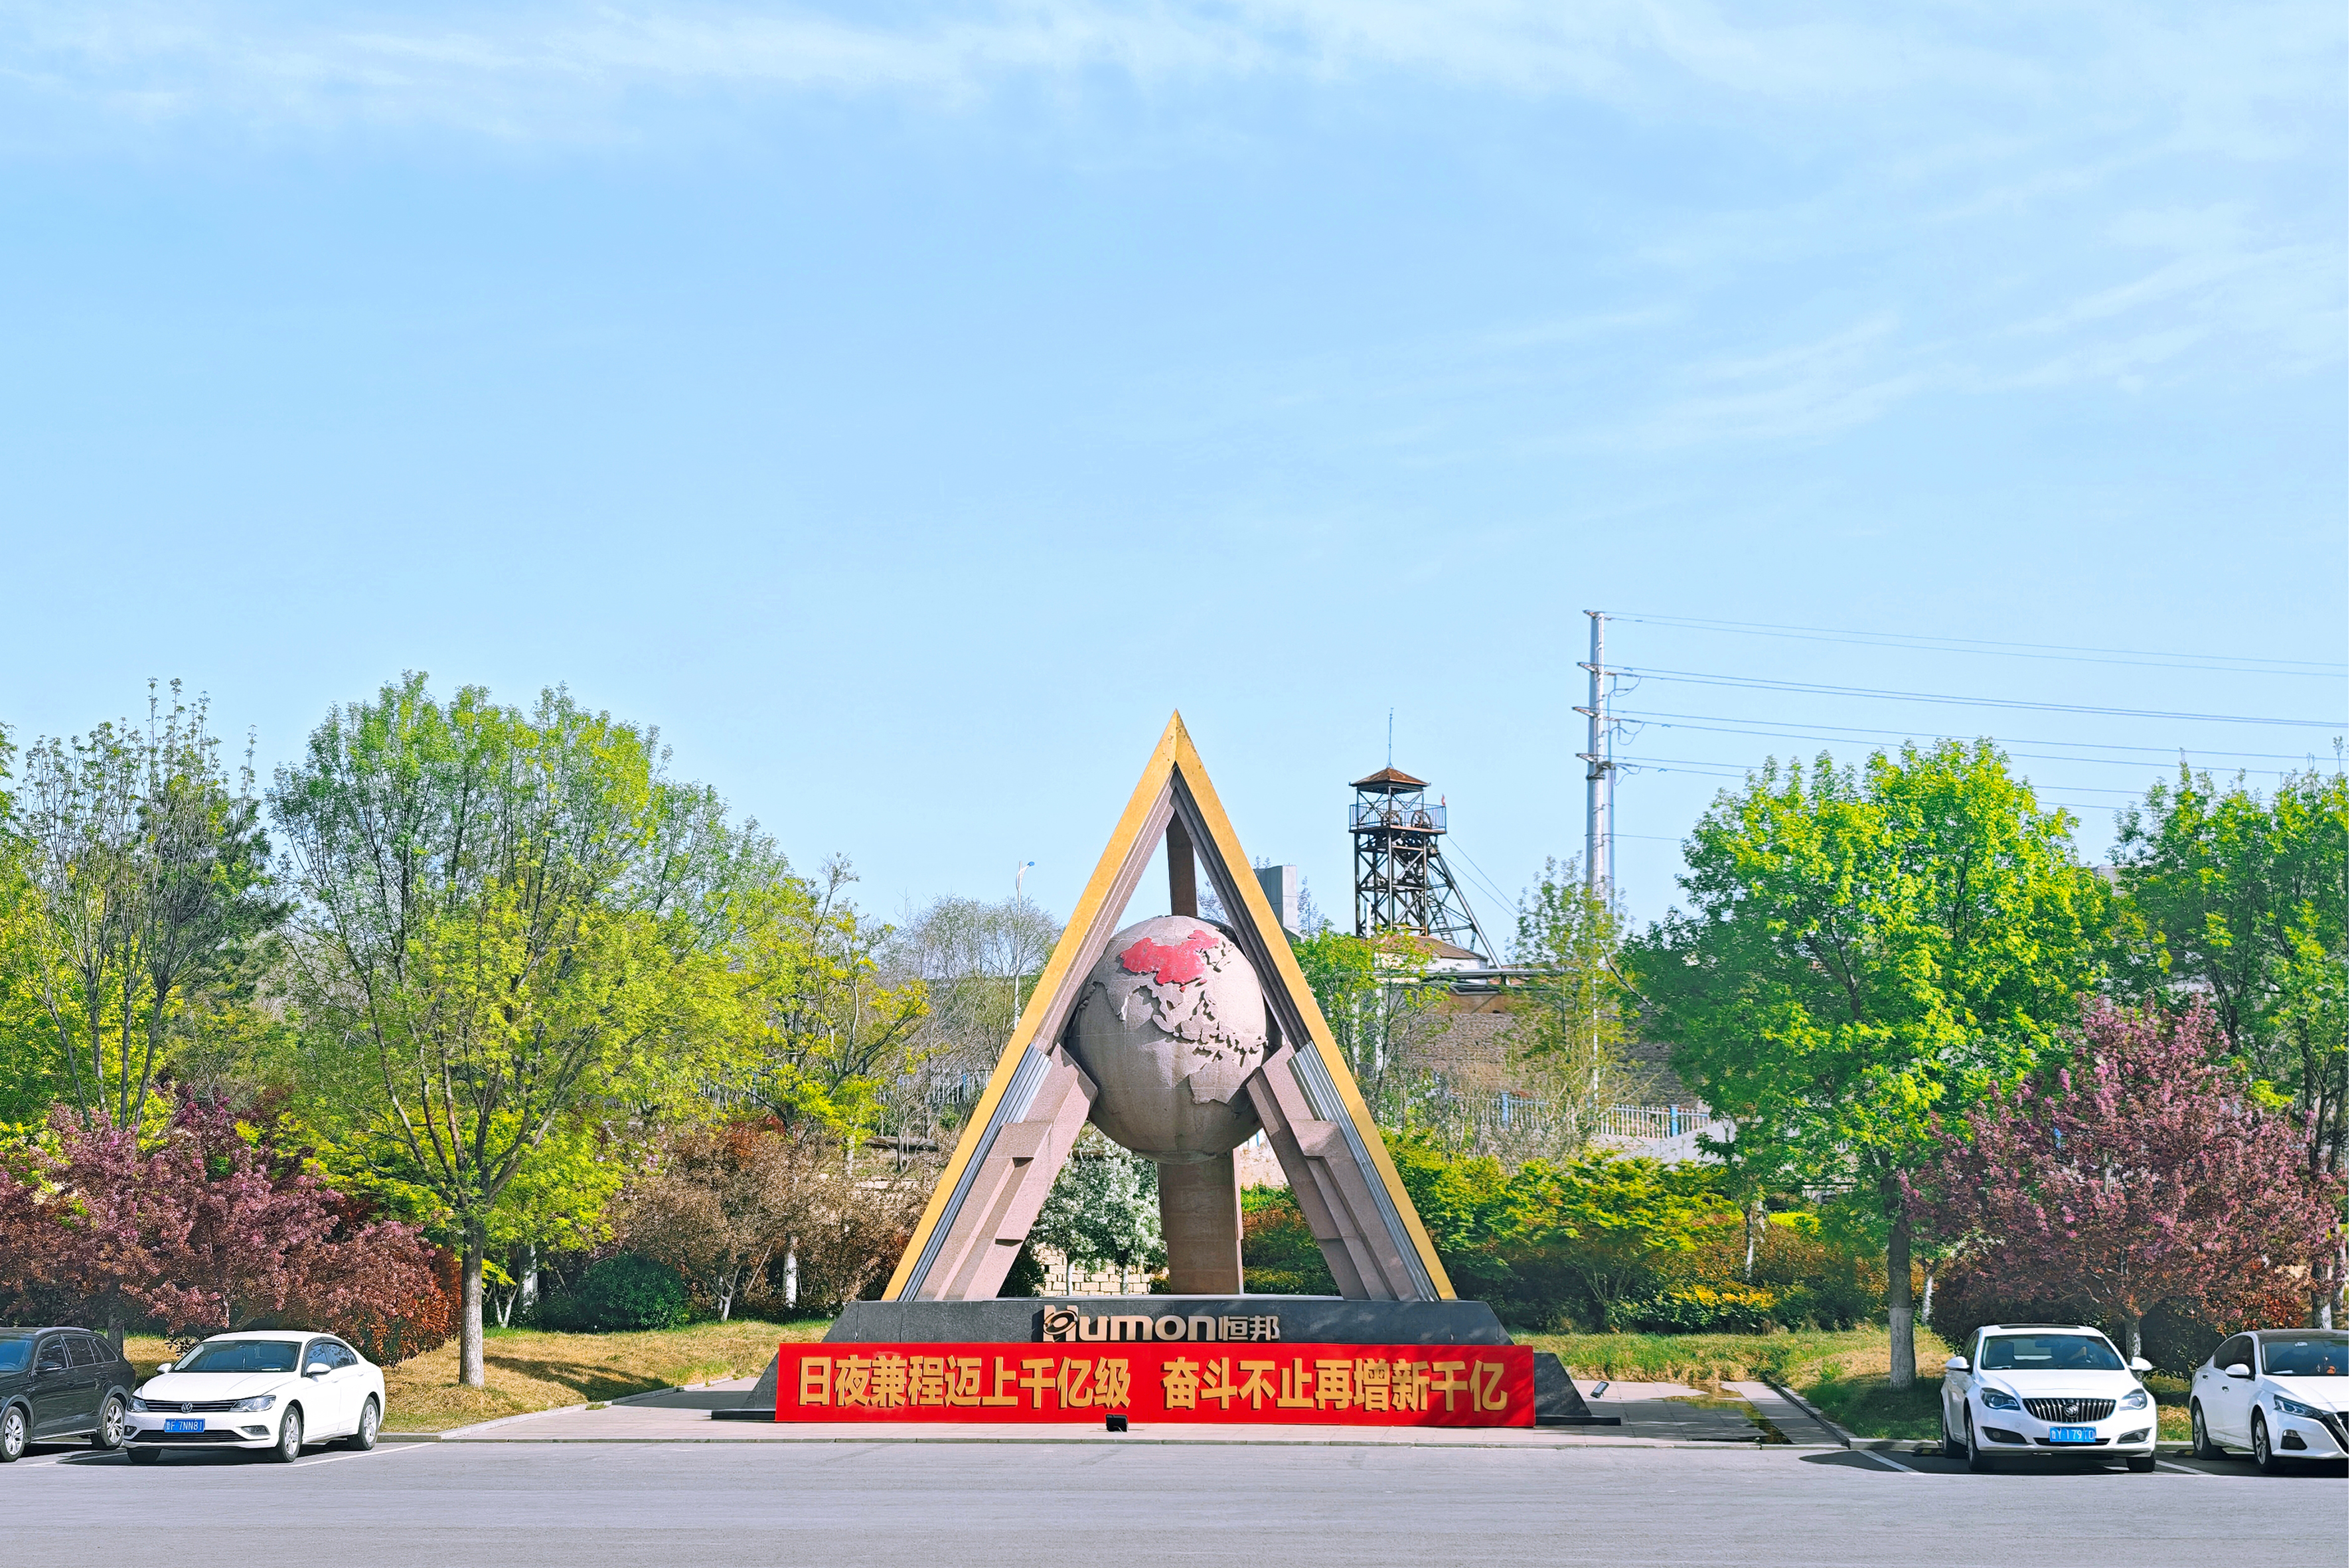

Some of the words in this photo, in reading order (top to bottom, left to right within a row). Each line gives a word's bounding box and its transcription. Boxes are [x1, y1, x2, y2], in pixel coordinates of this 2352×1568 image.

[1219, 1315, 1281, 1341] 恒邦
[798, 1354, 1131, 1409] 日夜兼程迈上千亿级
[1162, 1356, 1508, 1412] 奋斗不止再增新千亿
